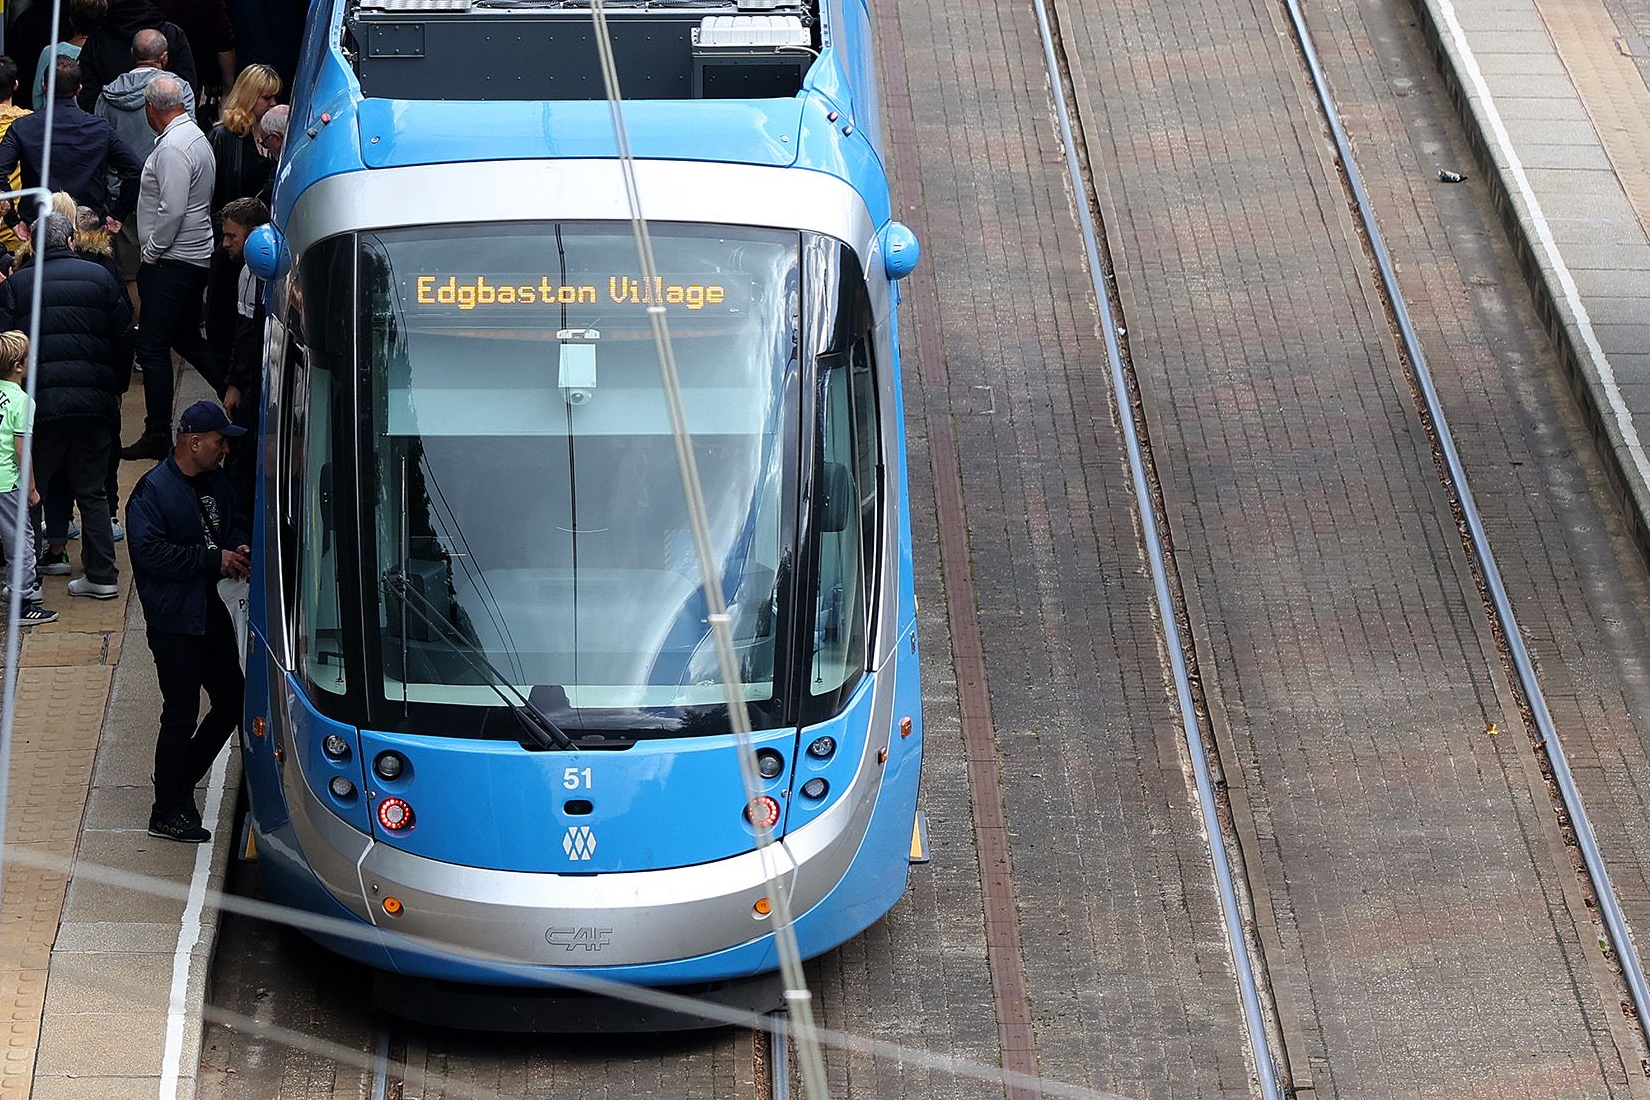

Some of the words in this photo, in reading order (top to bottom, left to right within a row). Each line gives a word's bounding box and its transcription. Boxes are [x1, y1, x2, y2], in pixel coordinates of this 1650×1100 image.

[417, 276, 597, 310] Edgbaston
[609, 276, 725, 310] Village
[562, 767, 592, 789] 51
[545, 926, 613, 951] CAF
